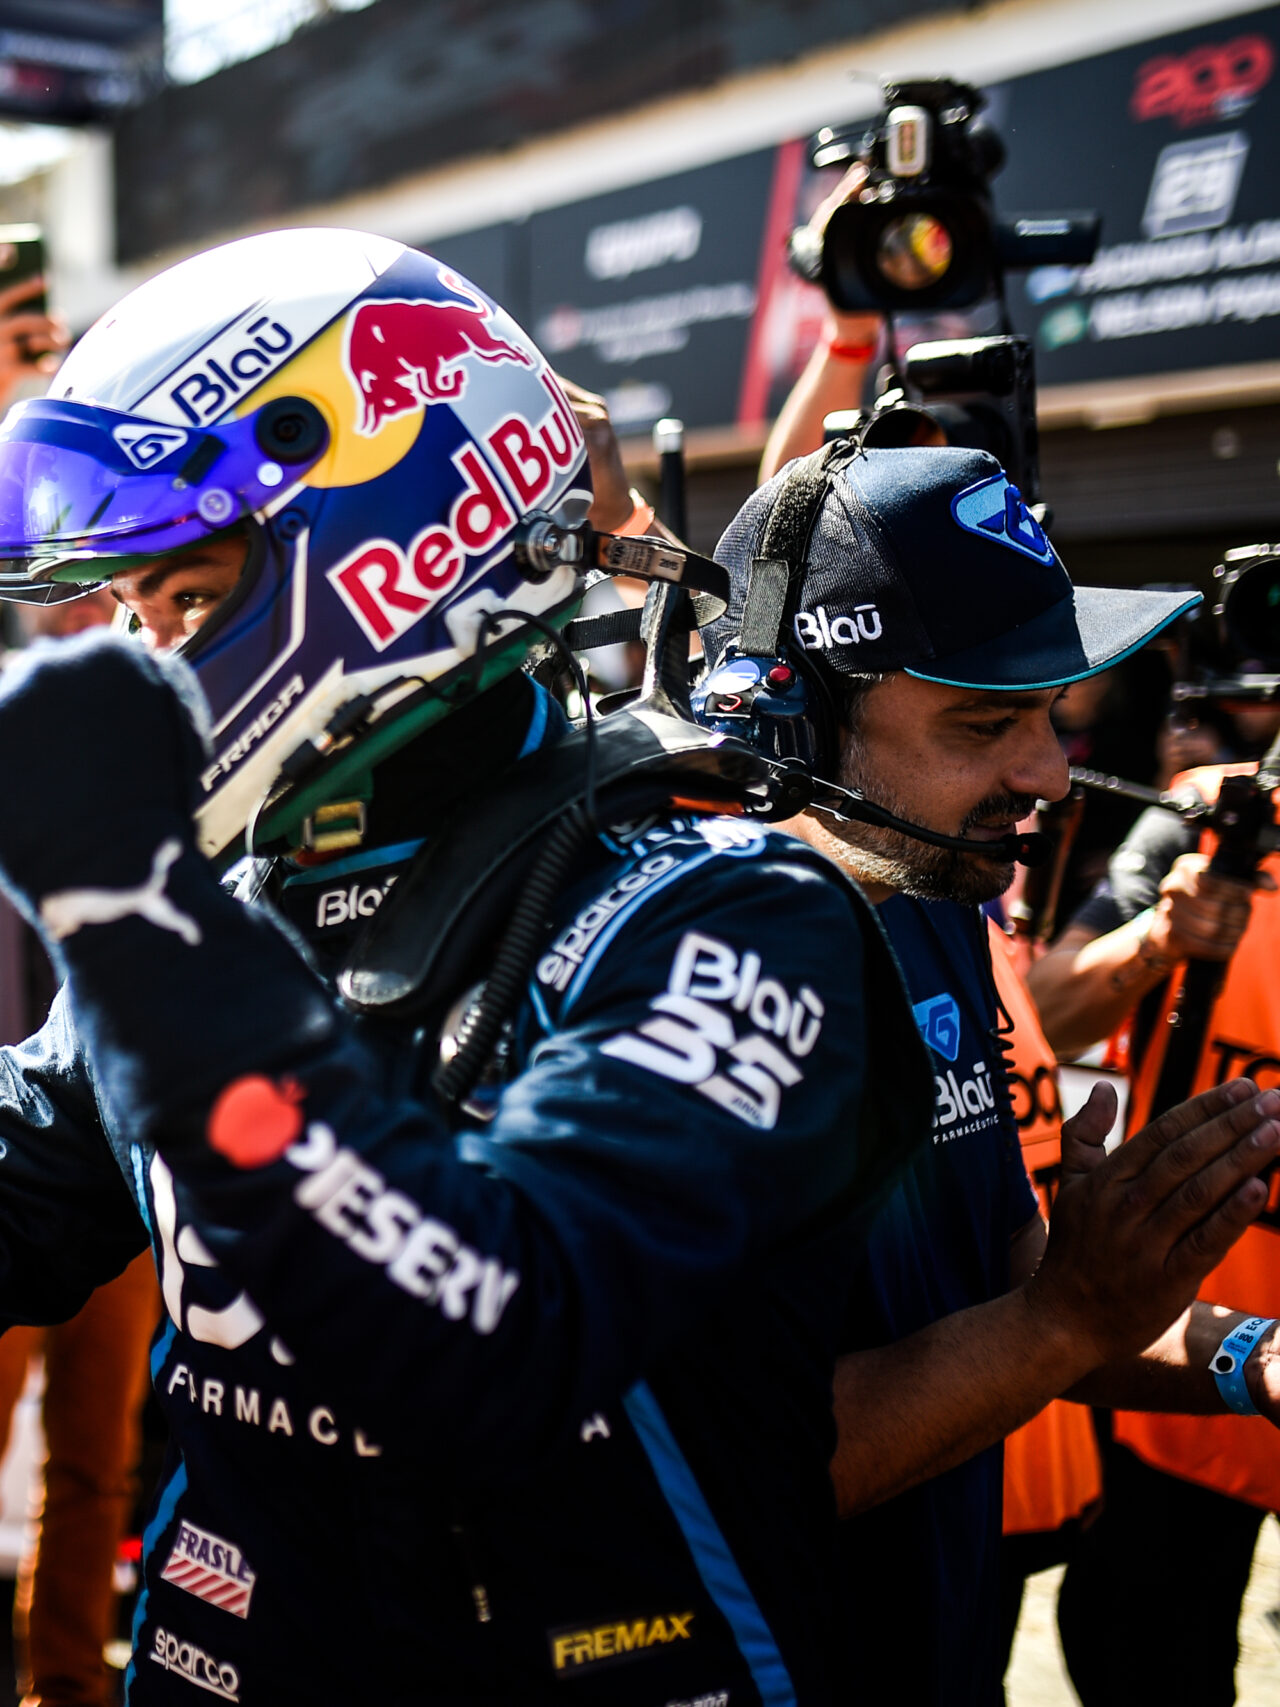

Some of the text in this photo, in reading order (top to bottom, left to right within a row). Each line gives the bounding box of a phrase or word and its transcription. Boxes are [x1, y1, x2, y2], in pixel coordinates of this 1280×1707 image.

[332, 366, 585, 646] Red Bull
[200, 674, 306, 793] FRAGA
[155, 1627, 239, 1694] sparco
[553, 1611, 695, 1669] FREMAX
